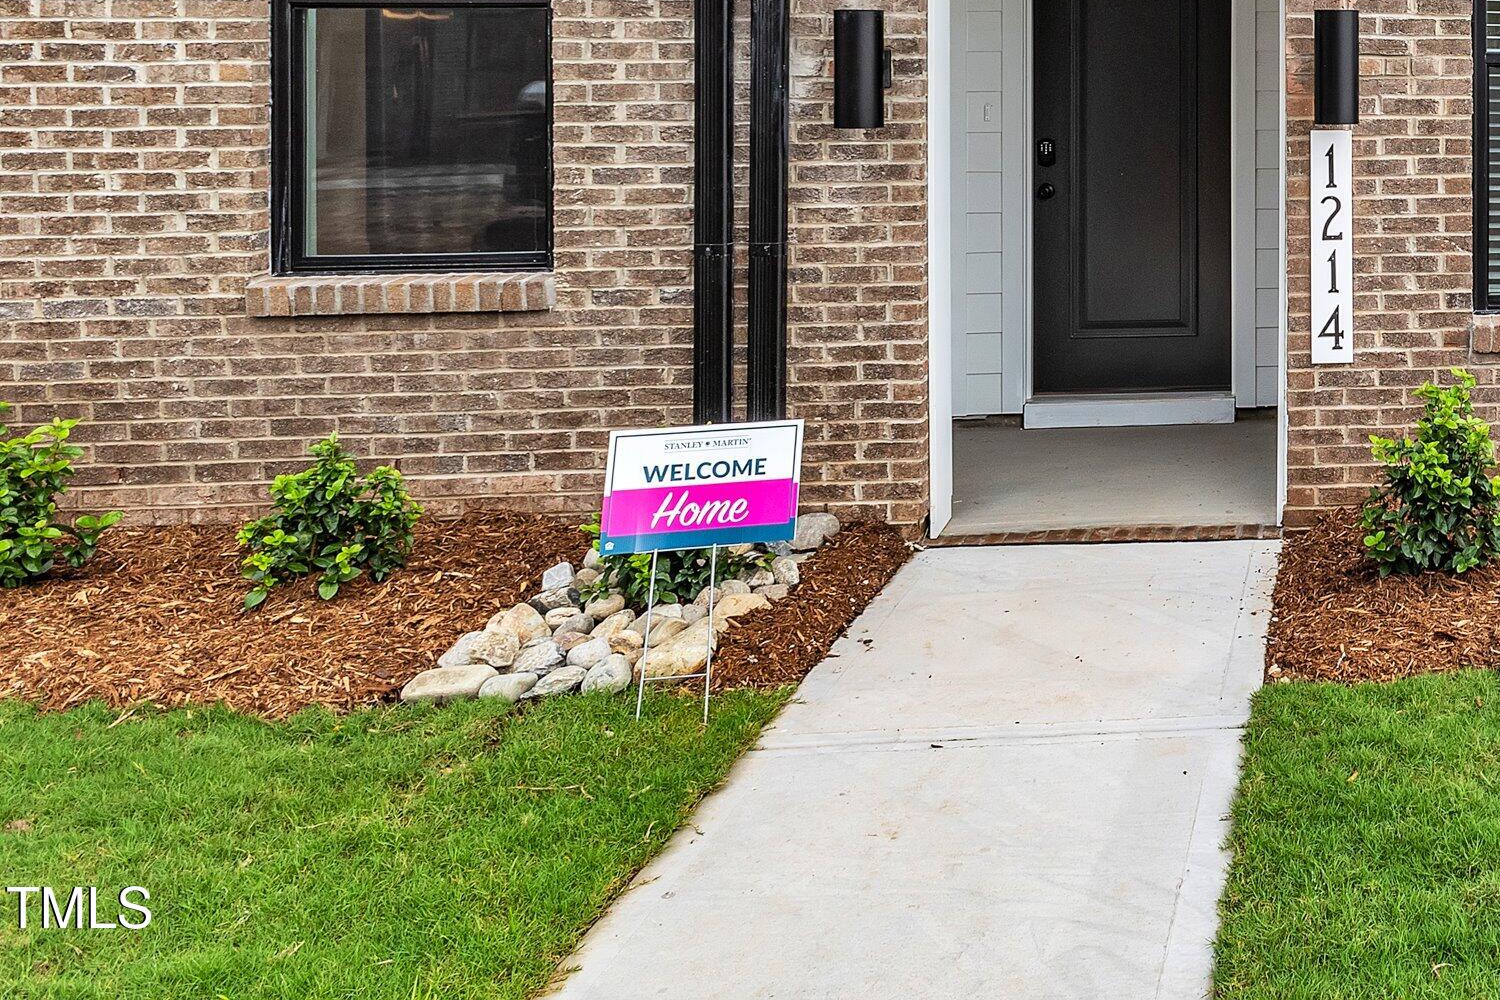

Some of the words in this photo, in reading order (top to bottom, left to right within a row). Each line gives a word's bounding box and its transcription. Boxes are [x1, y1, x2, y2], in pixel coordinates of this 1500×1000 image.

[1318, 143, 1344, 349] 1214
[664, 441, 703, 450] STANLEY
[643, 458, 766, 483] WELCOME
[651, 490, 749, 529] Home
